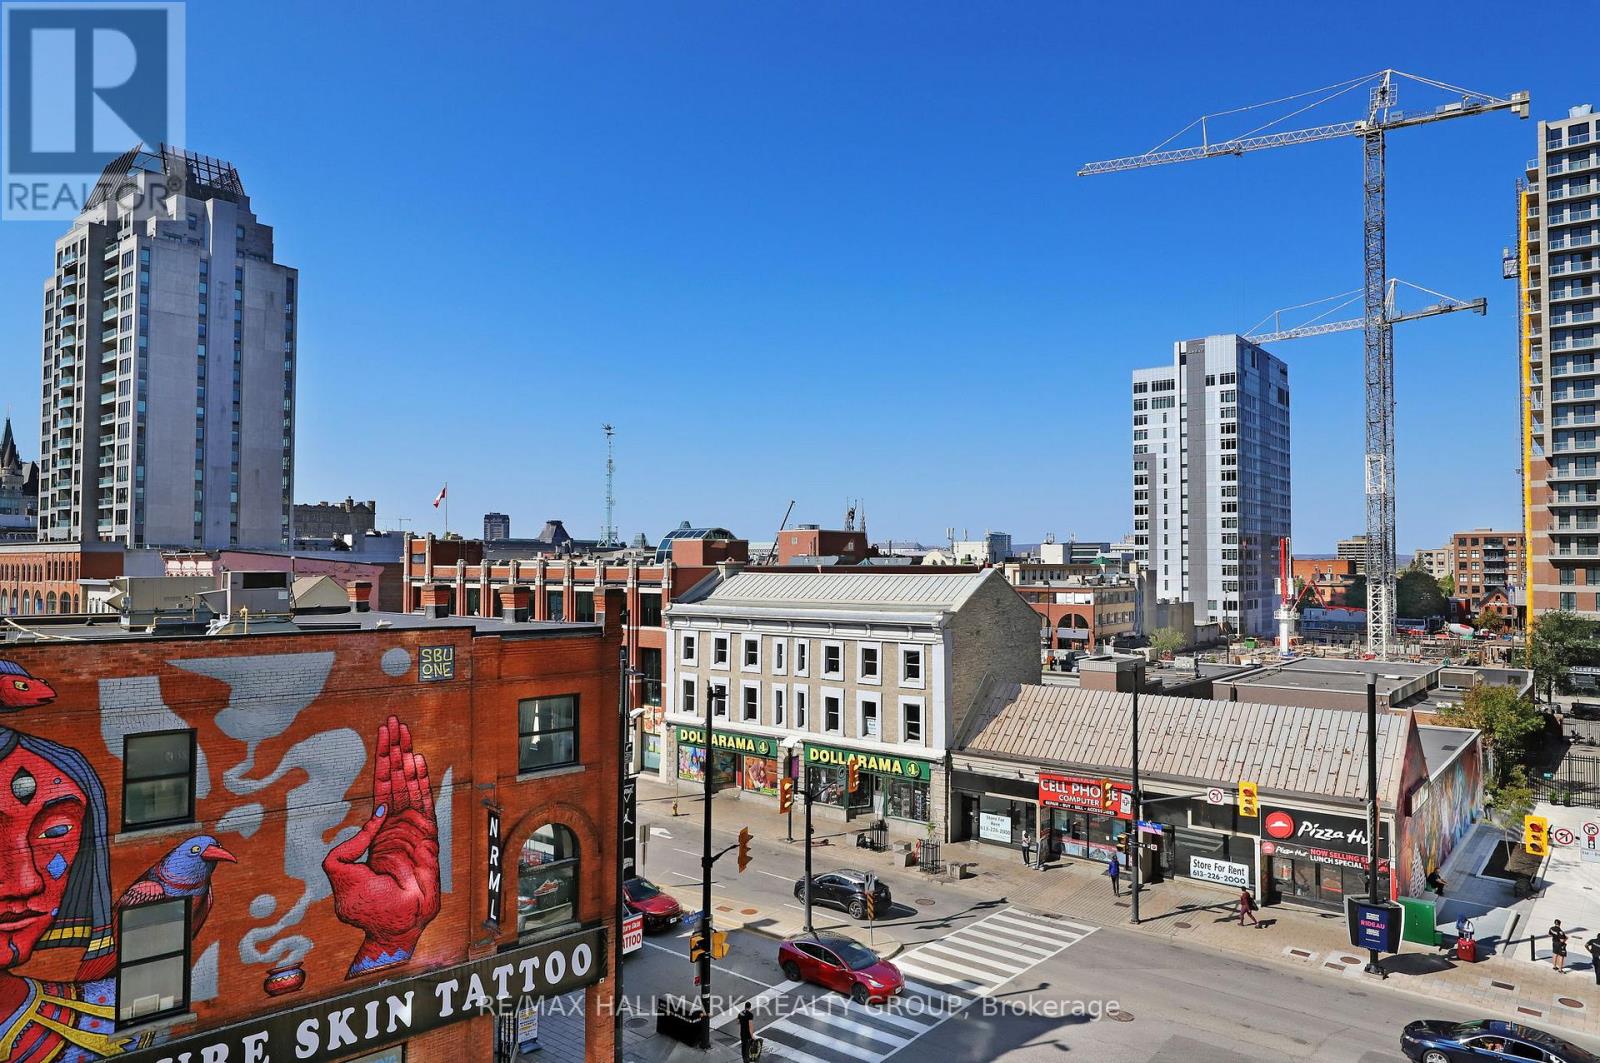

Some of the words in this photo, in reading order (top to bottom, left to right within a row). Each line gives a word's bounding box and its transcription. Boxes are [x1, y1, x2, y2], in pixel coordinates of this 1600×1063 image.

[422, 662, 453, 679] ONE
[1040, 780, 1068, 794] CELL
[1058, 794, 1100, 807] COMPUTER
[1297, 820, 1345, 841] Pizza
[1310, 848, 1329, 858] NOW
[1329, 851, 1360, 863] SELLING
[1310, 855, 1334, 867] LUNCH
[1334, 858, 1363, 870] SPECIAL
[1193, 859, 1212, 872] Store
[1214, 862, 1226, 873] For
[1228, 864, 1245, 876] Rent
[1192, 870, 1246, 885] 613-226-2000
[1360, 919, 1386, 930] RIDEAU
[295, 990, 415, 1059] SKIN
[434, 943, 593, 1018] TATTOO
